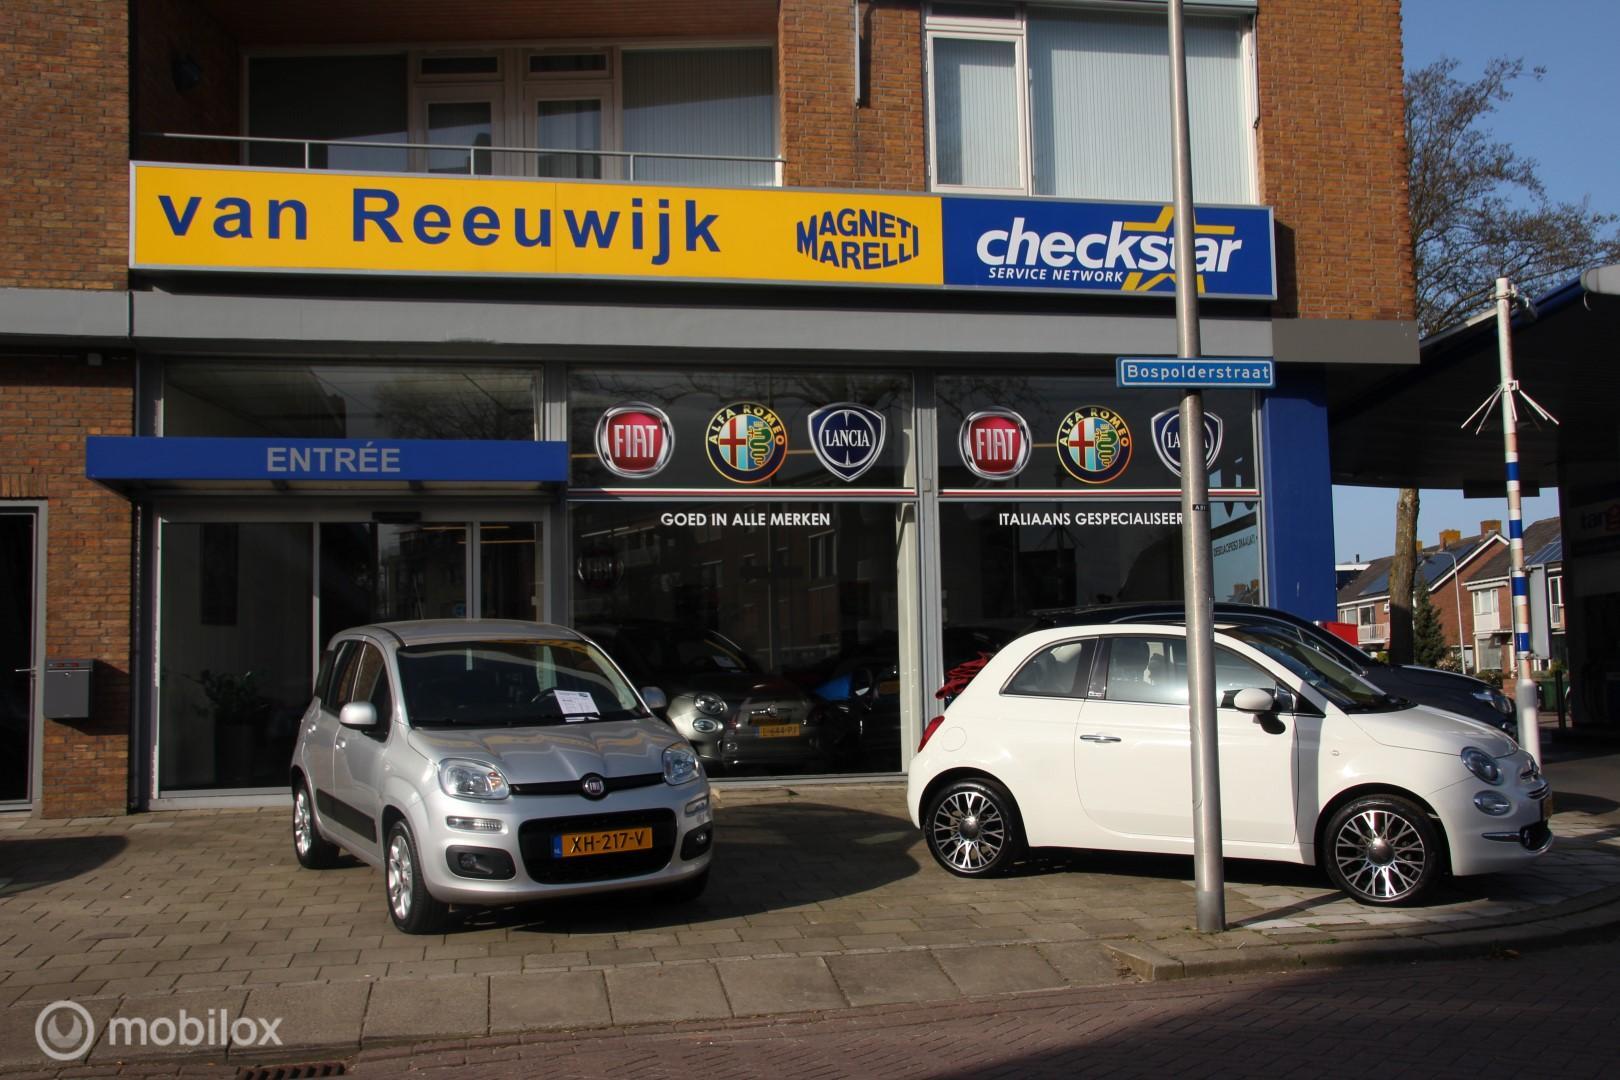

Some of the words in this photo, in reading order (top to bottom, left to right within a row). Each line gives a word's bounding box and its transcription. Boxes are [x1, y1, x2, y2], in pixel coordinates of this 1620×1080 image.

[157, 194, 308, 241] van
[352, 187, 721, 266] Reeuwijk
[796, 208, 919, 252] MAGNETI
[796, 228, 919, 270] MARELLI
[976, 216, 1243, 273] checksar
[988, 267, 1047, 280] SERVICE
[1052, 269, 1124, 283] NETWORK
[1127, 364, 1270, 381] Bospolderstraat
[613, 424, 658, 458] FIAT
[708, 408, 737, 446] ALFA
[743, 404, 785, 446] ROMEO
[825, 429, 871, 448] LANCIA
[1059, 411, 1084, 447] ALFA
[1090, 406, 1130, 447] ROMEO
[266, 441, 401, 473] ENTRÉE
[975, 428, 1016, 460] FIAT
[660, 512, 708, 526] GOED
[711, 512, 728, 526] IN
[732, 512, 766, 526] ALLE
[769, 512, 831, 526] MERKEN
[998, 512, 1071, 526] ITALIAANS
[1075, 512, 1183, 526] GESPECIALISEER
[570, 830, 645, 854] XH-217-V
